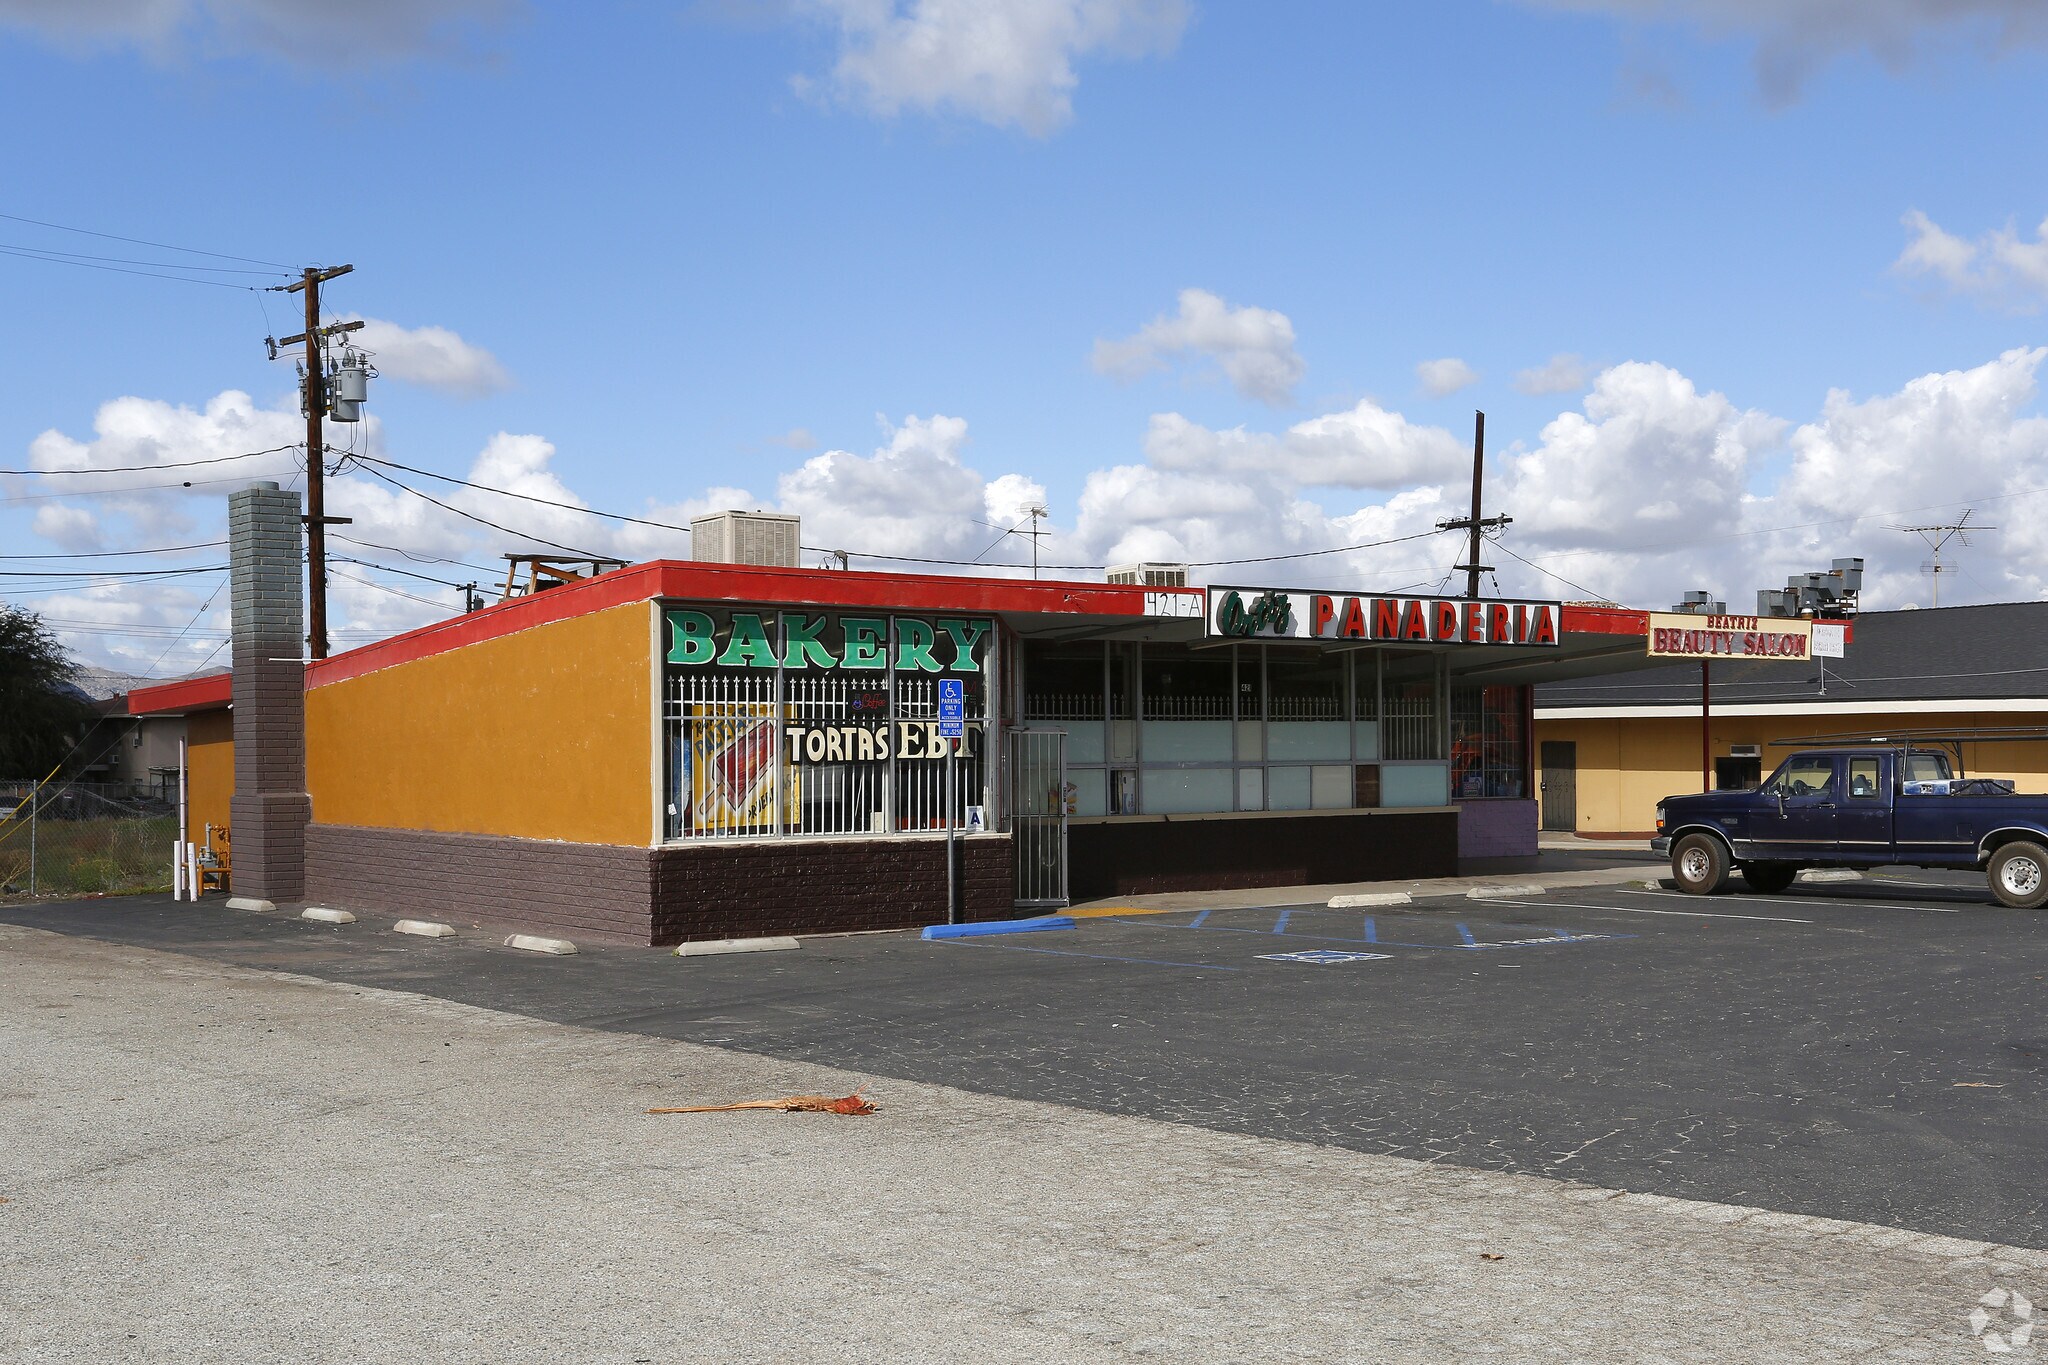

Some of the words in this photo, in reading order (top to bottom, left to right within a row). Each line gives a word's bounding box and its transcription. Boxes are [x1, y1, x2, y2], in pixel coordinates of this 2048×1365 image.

[1310, 595, 1555, 643] PANADERIA
[1706, 615, 1758, 631] BEATRIZ
[666, 610, 990, 672] BAKERY
[1653, 627, 1735, 655] BEAUTY
[1743, 631, 1808, 658] SALON
[786, 727, 889, 762] TORTAS
[898, 722, 984, 759] EBT
[970, 812, 981, 824] A
